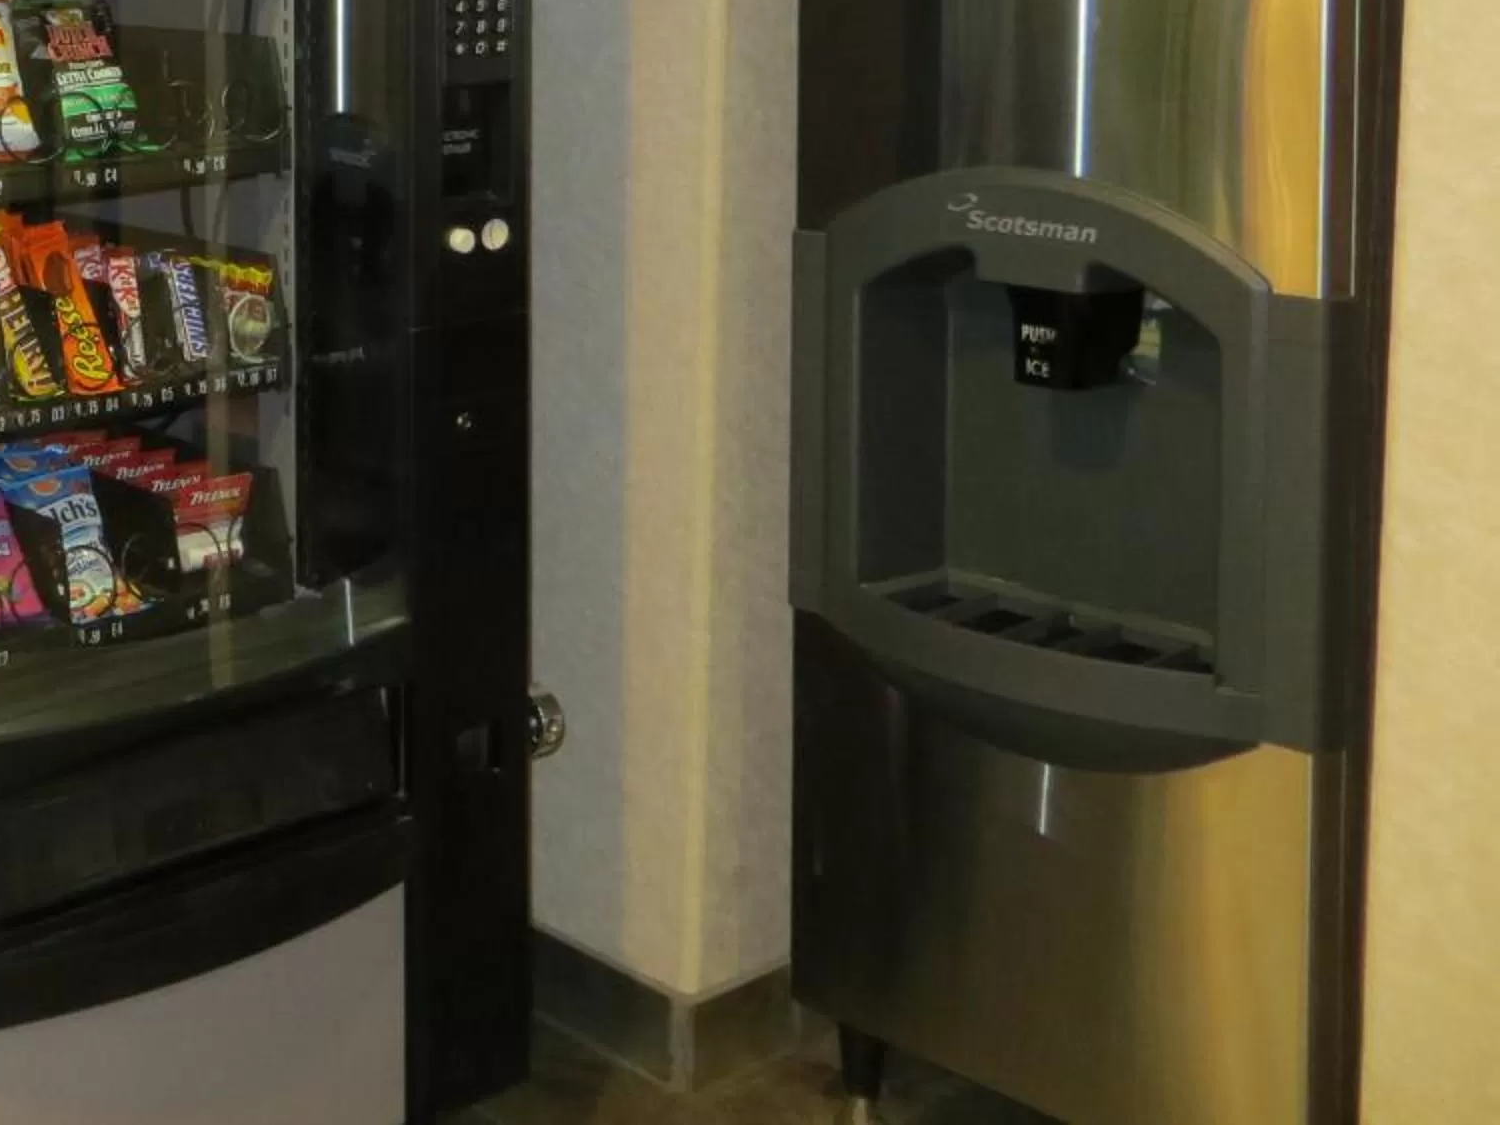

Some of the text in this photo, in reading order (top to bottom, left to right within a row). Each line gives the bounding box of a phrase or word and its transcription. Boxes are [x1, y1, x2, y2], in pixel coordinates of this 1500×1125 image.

[966, 210, 1098, 244] Scotsman
[1025, 357, 1051, 378] ICE
[52, 498, 97, 525] lch's
